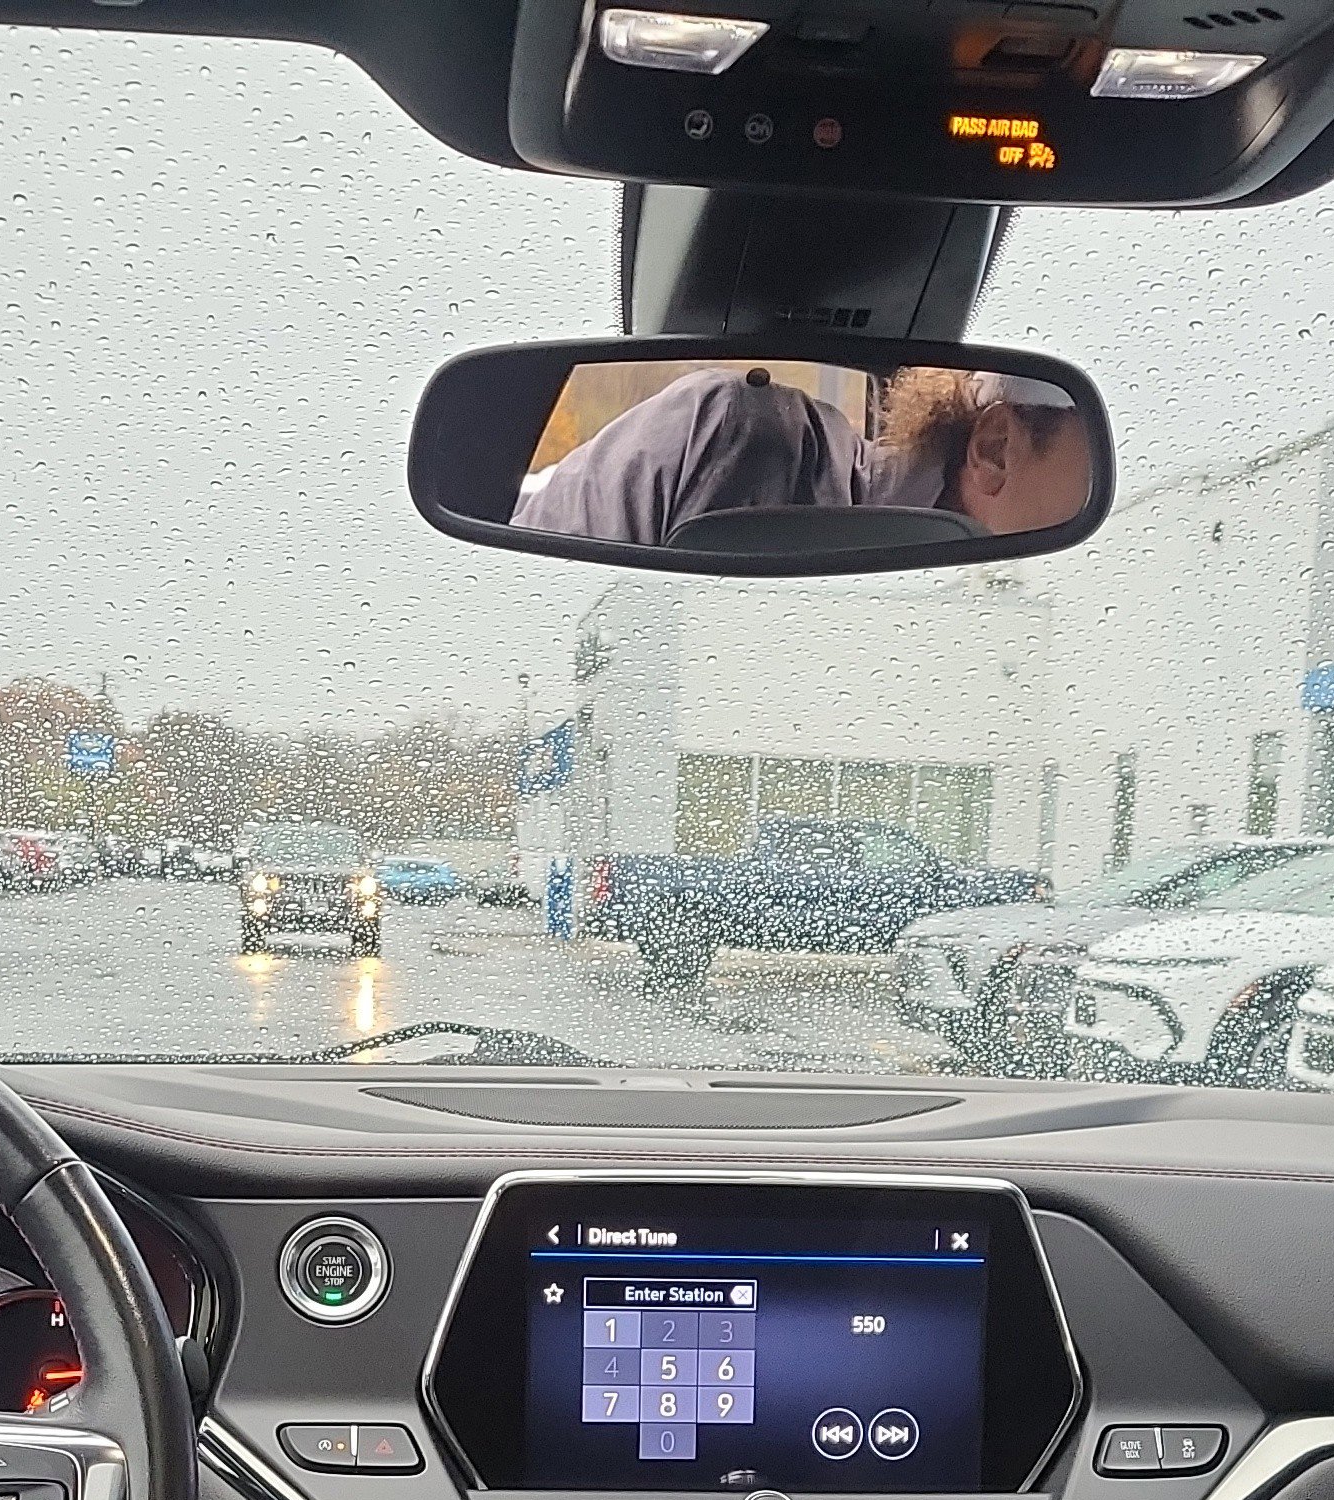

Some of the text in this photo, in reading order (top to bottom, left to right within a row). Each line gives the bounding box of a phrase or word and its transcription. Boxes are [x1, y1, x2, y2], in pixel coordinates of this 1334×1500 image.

[951, 116, 1039, 138] PASS AIR BAG
[999, 146, 1025, 165] OFF
[588, 1227, 678, 1246] Direct Tune
[323, 1256, 347, 1265] START
[315, 1265, 354, 1277] ENGINE
[324, 1277, 345, 1286] STOP
[625, 1285, 725, 1302] Enter Station
[51, 1313, 64, 1327] H
[853, 1316, 886, 1334] 550
[605, 1318, 733, 1343] 1 2 3
[604, 1356, 735, 1381] 4 5 6
[603, 1392, 734, 1418] 7 8 9
[660, 1431, 675, 1454] 0
[1120, 1440, 1142, 1450] GLOVE
[1125, 1449, 1140, 1459] BOX
